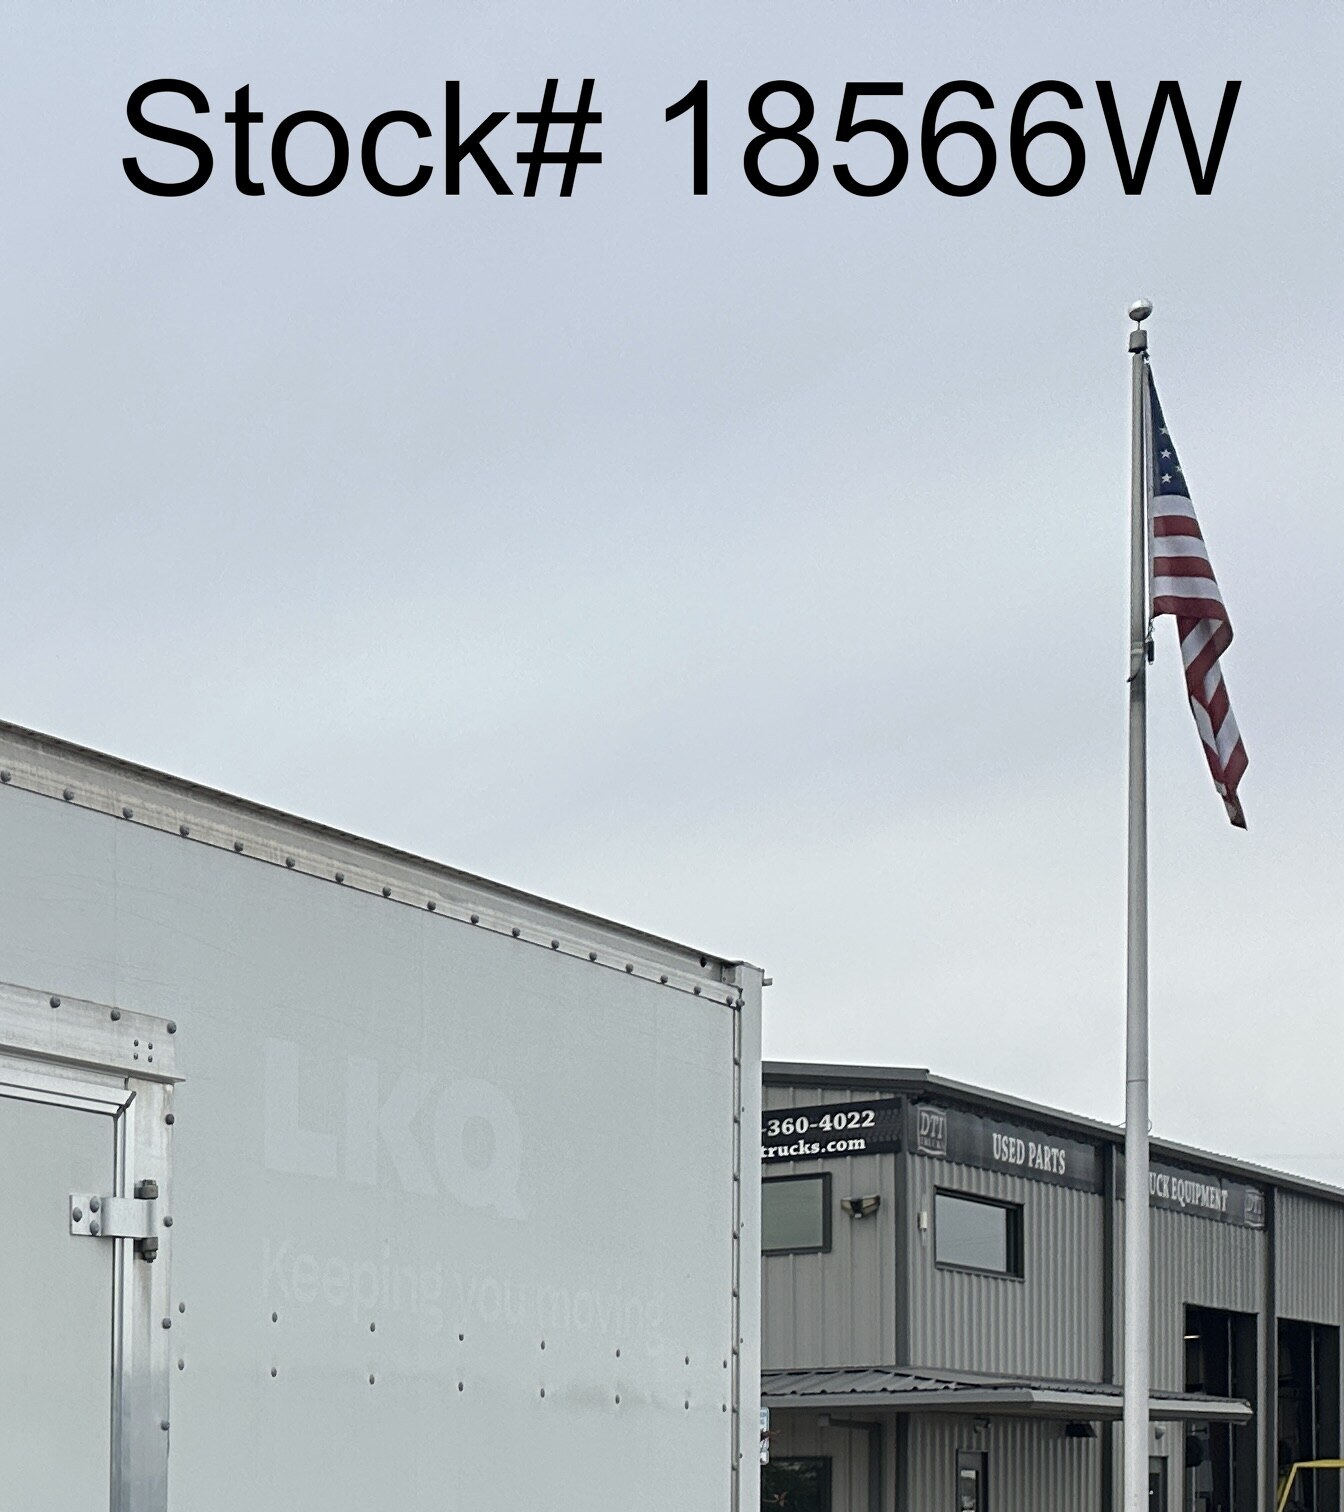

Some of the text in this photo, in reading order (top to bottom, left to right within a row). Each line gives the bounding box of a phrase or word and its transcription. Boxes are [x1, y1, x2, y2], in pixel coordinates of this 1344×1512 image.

[264, 1037, 528, 1221] LKQ
[920, 1111, 944, 1139] DTI
[992, 1133, 1066, 1175] USED PARTS
[1149, 1171, 1229, 1212] UCK EQUIPMENT
